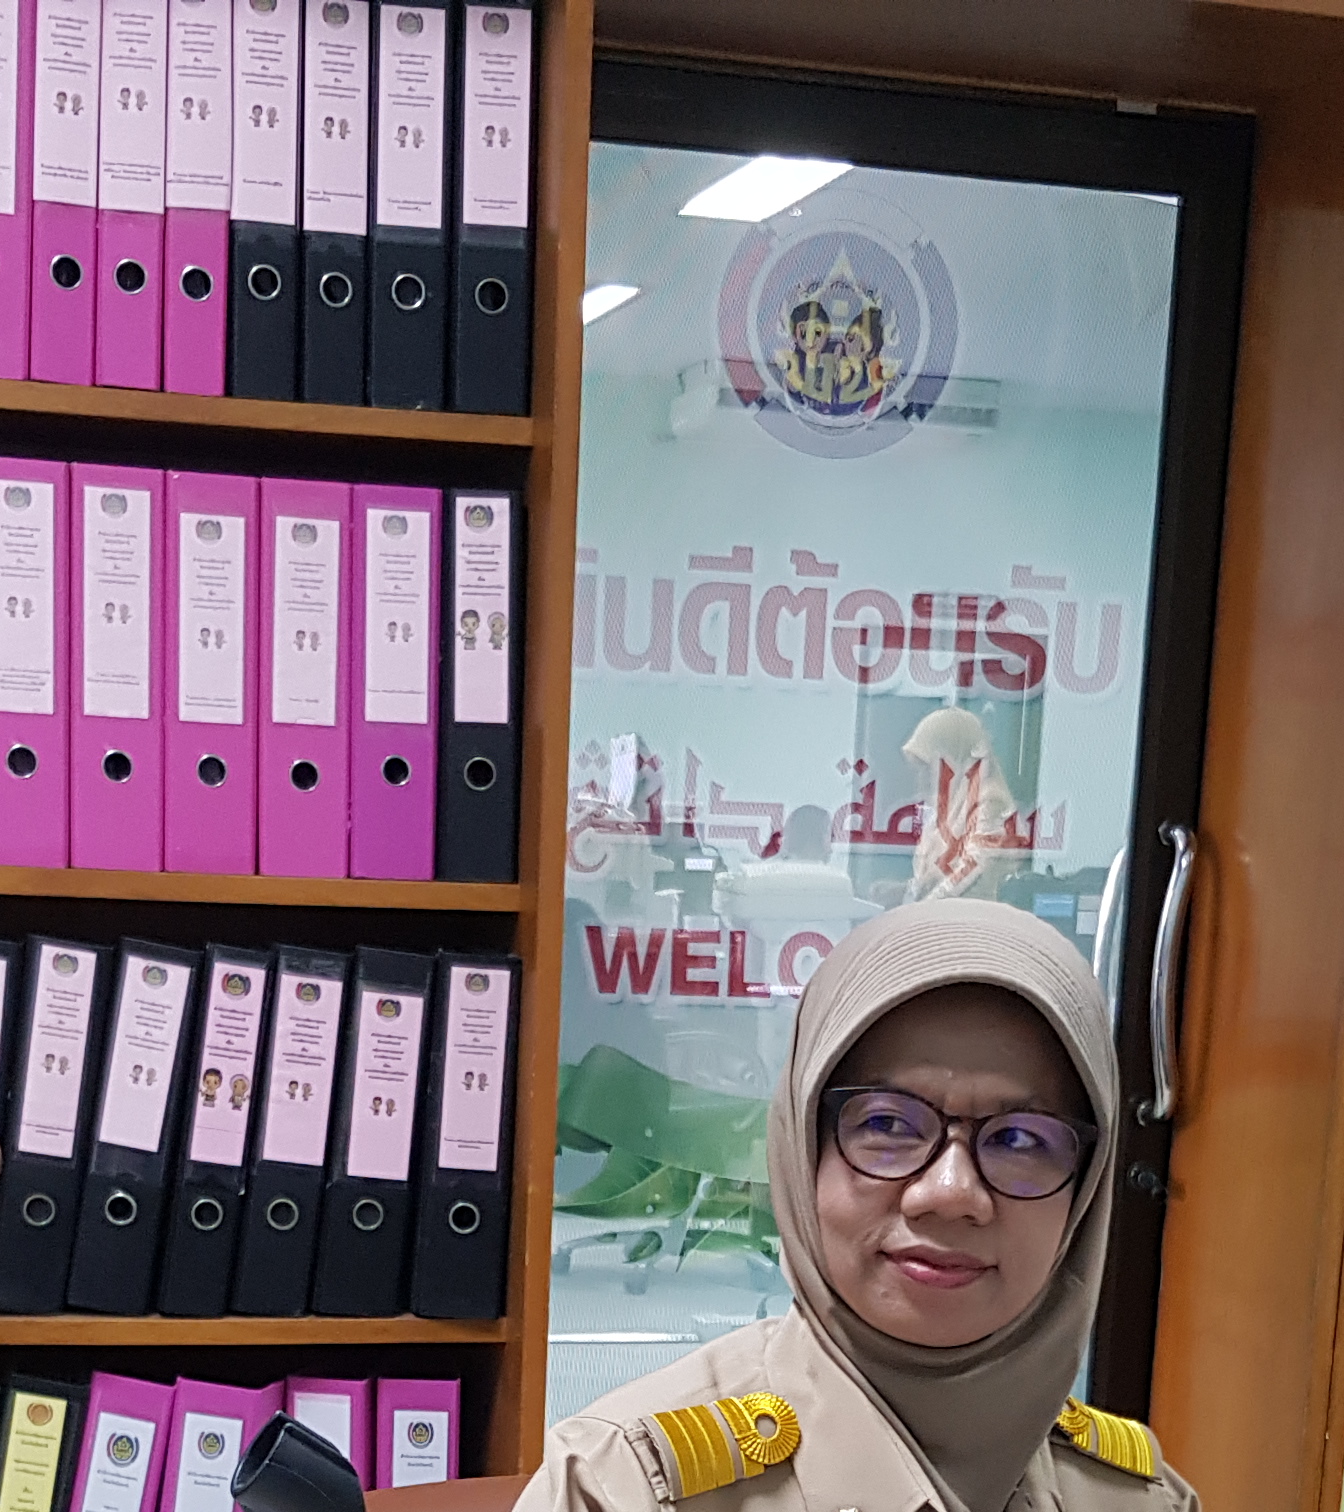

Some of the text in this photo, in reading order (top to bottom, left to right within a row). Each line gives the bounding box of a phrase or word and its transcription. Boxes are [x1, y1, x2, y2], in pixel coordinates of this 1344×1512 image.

[575, 546, 1123, 694] นดีต้อนรับ
[585, 924, 836, 999] WELC
